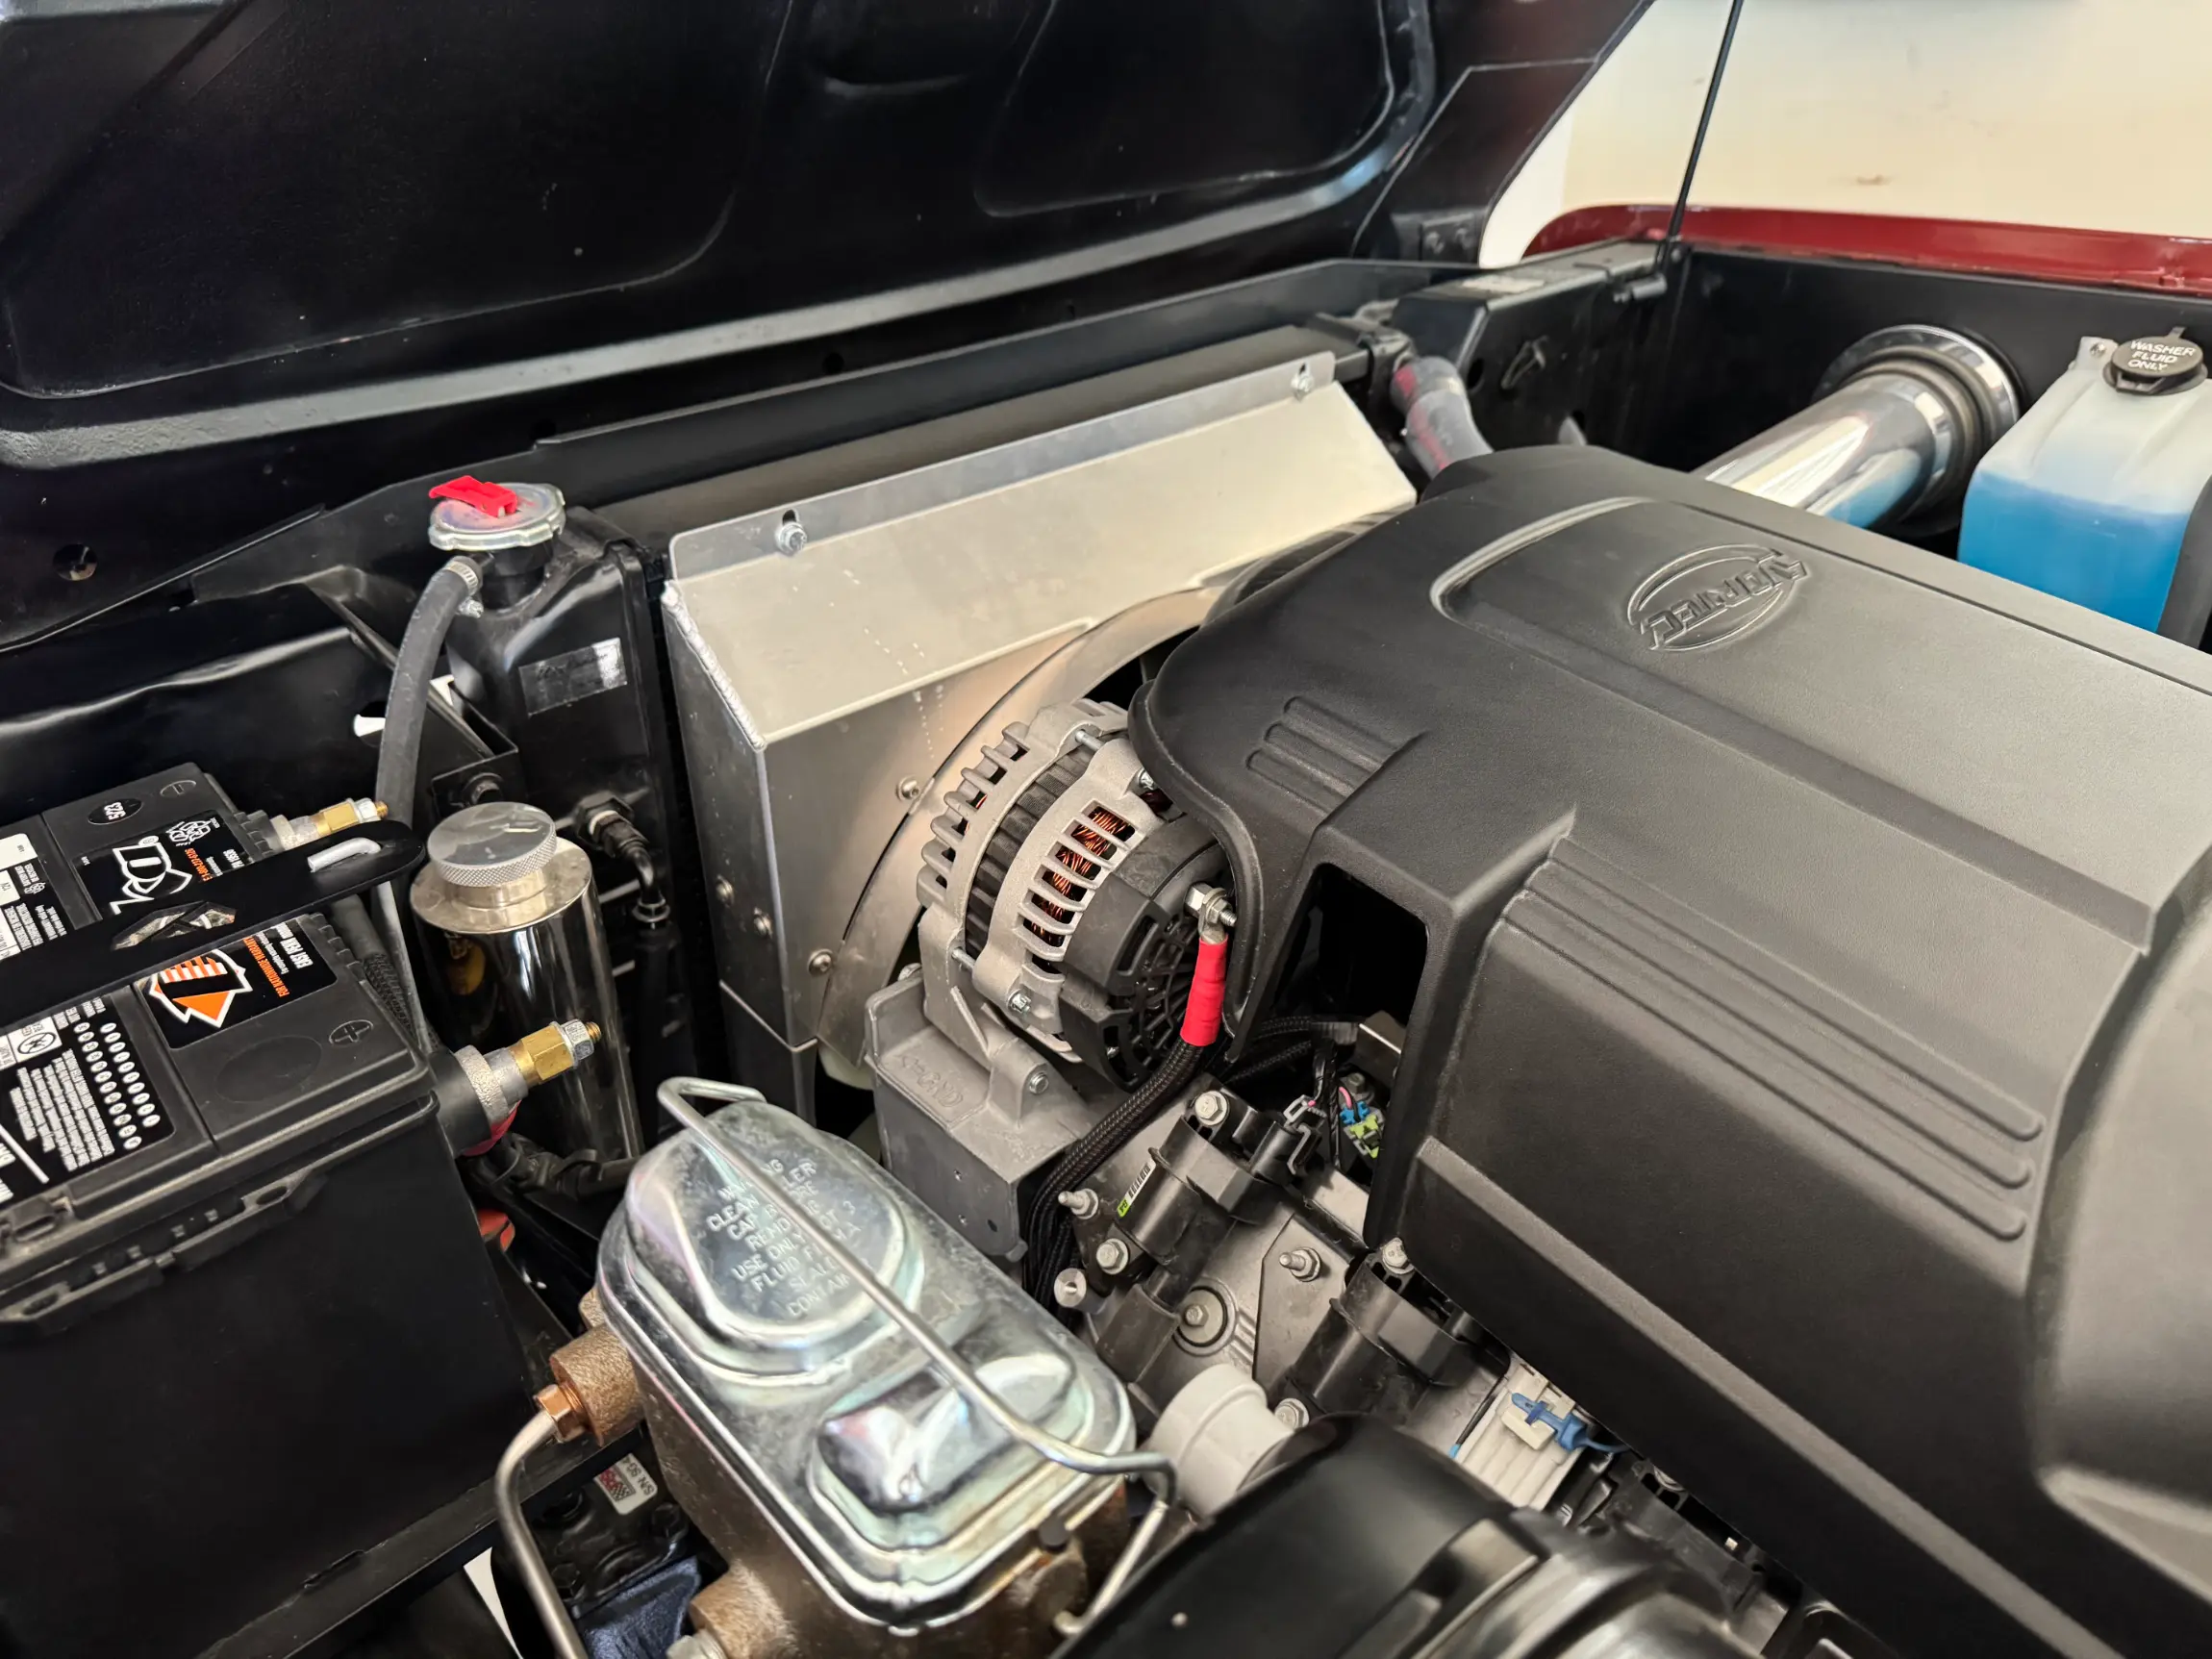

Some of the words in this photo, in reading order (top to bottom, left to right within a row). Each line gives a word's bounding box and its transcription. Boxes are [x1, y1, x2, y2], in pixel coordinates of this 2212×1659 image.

[2130, 340, 2197, 356] WASHER
[2127, 359, 2168, 370] ONLY
[2131, 351, 2178, 364] FLUID
[279, 937, 304, 955] PENN
[289, 951, 314, 969] EAST
[706, 1194, 760, 1232] CLEAN
[730, 1254, 767, 1282] USE
[766, 1228, 807, 1262] ONLY
[842, 1200, 857, 1216] 3
[750, 1256, 800, 1293] FLUID
